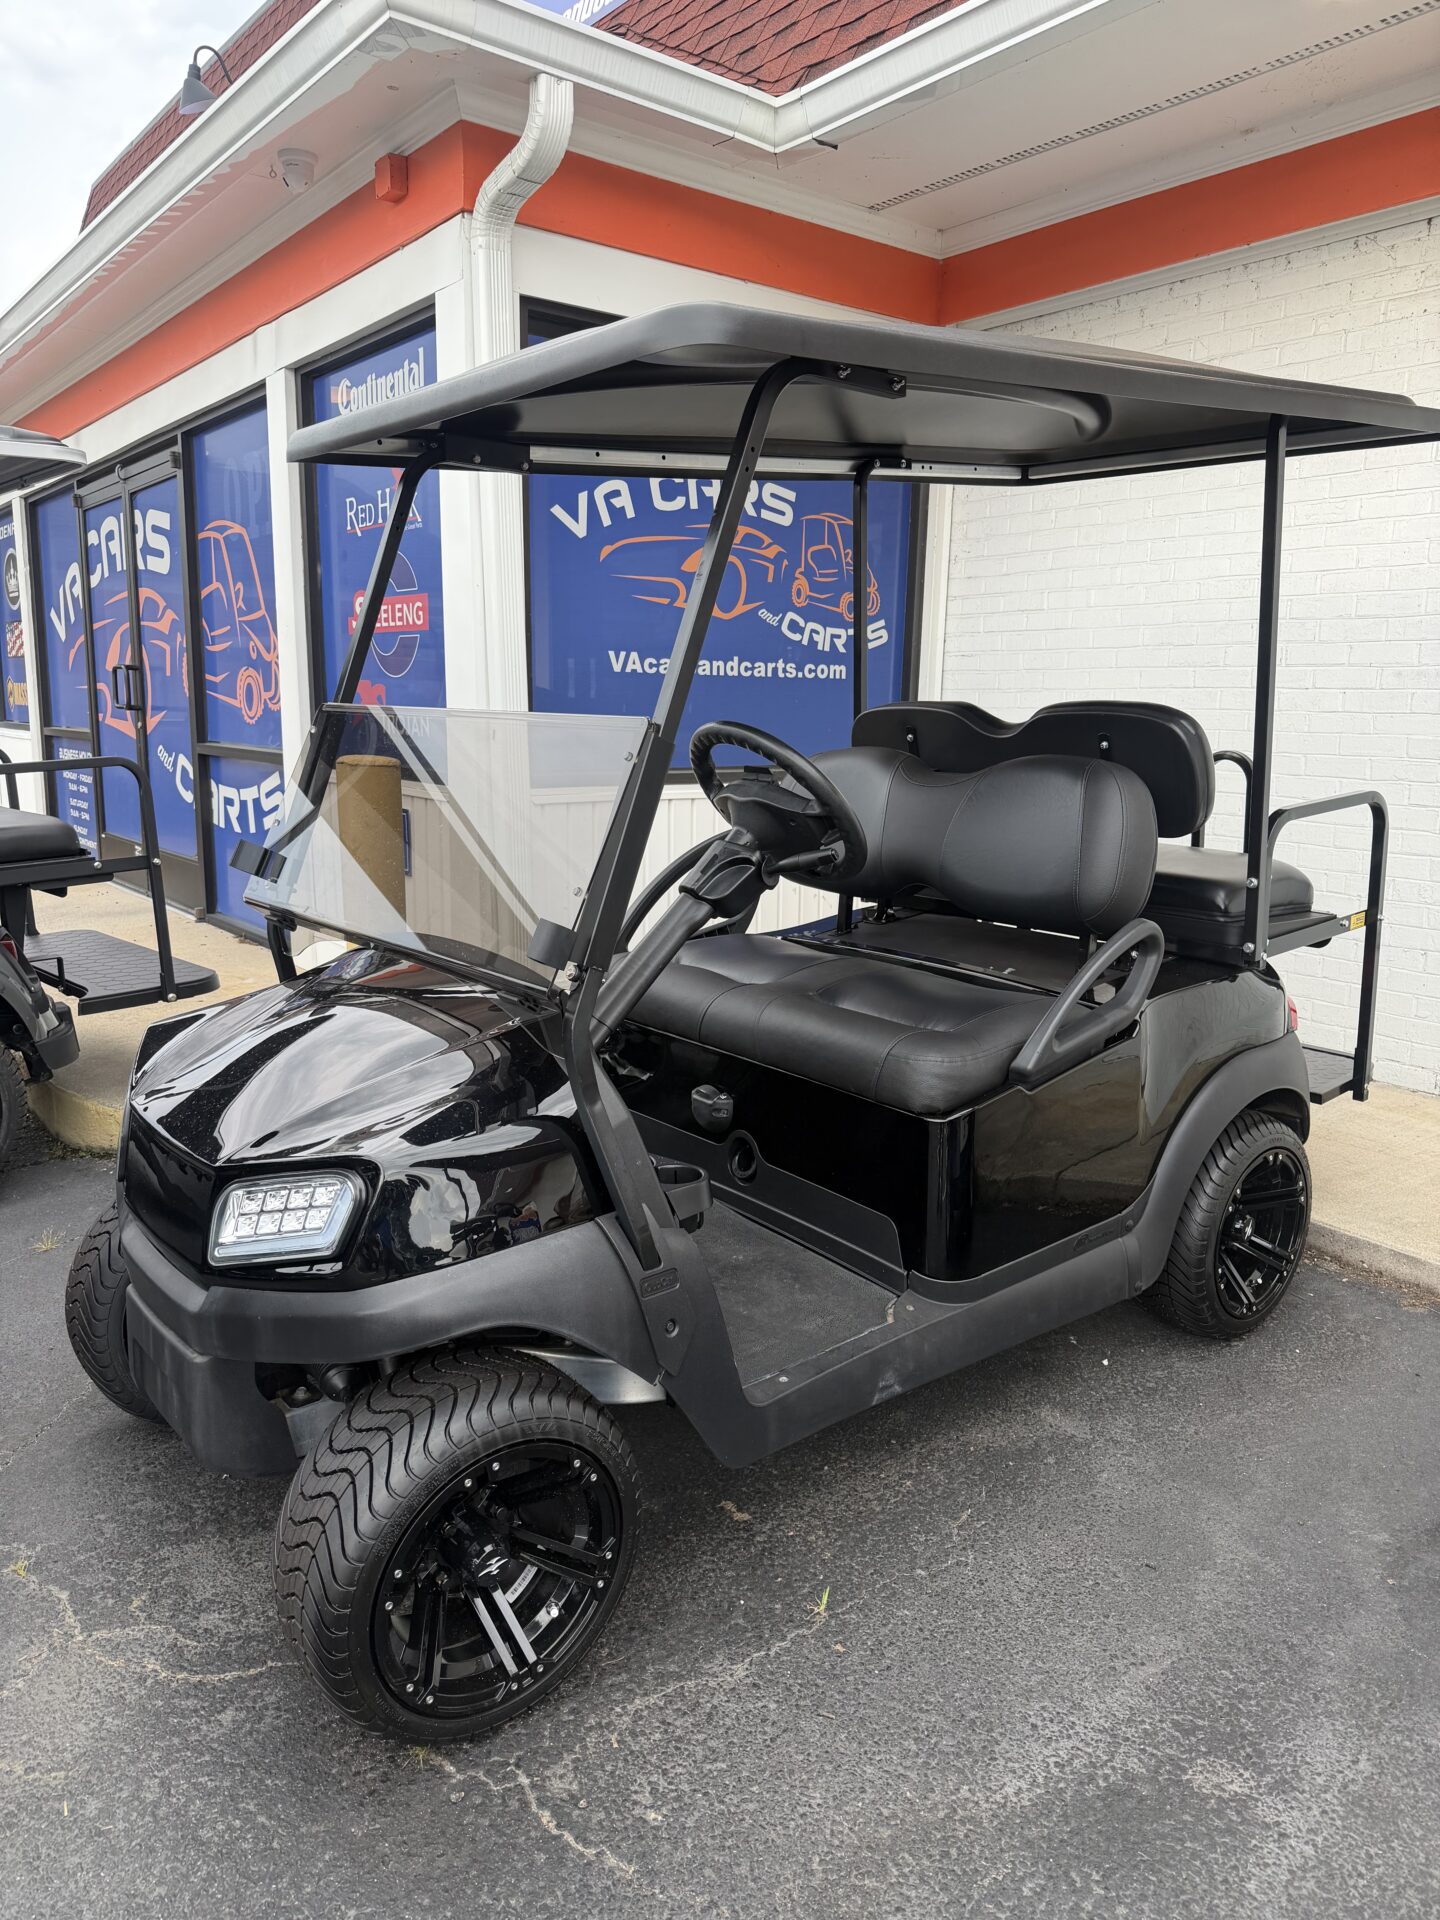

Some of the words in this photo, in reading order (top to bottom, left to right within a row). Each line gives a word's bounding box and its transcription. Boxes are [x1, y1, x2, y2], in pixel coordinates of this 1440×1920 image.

[337, 346, 425, 416] Continental
[345, 497, 375, 536] RED
[550, 480, 636, 539] VA
[50, 561, 83, 633] VA
[758, 607, 780, 628] and
[607, 650, 848, 681] VAcaandcarts.com
[157, 744, 176, 773] and
